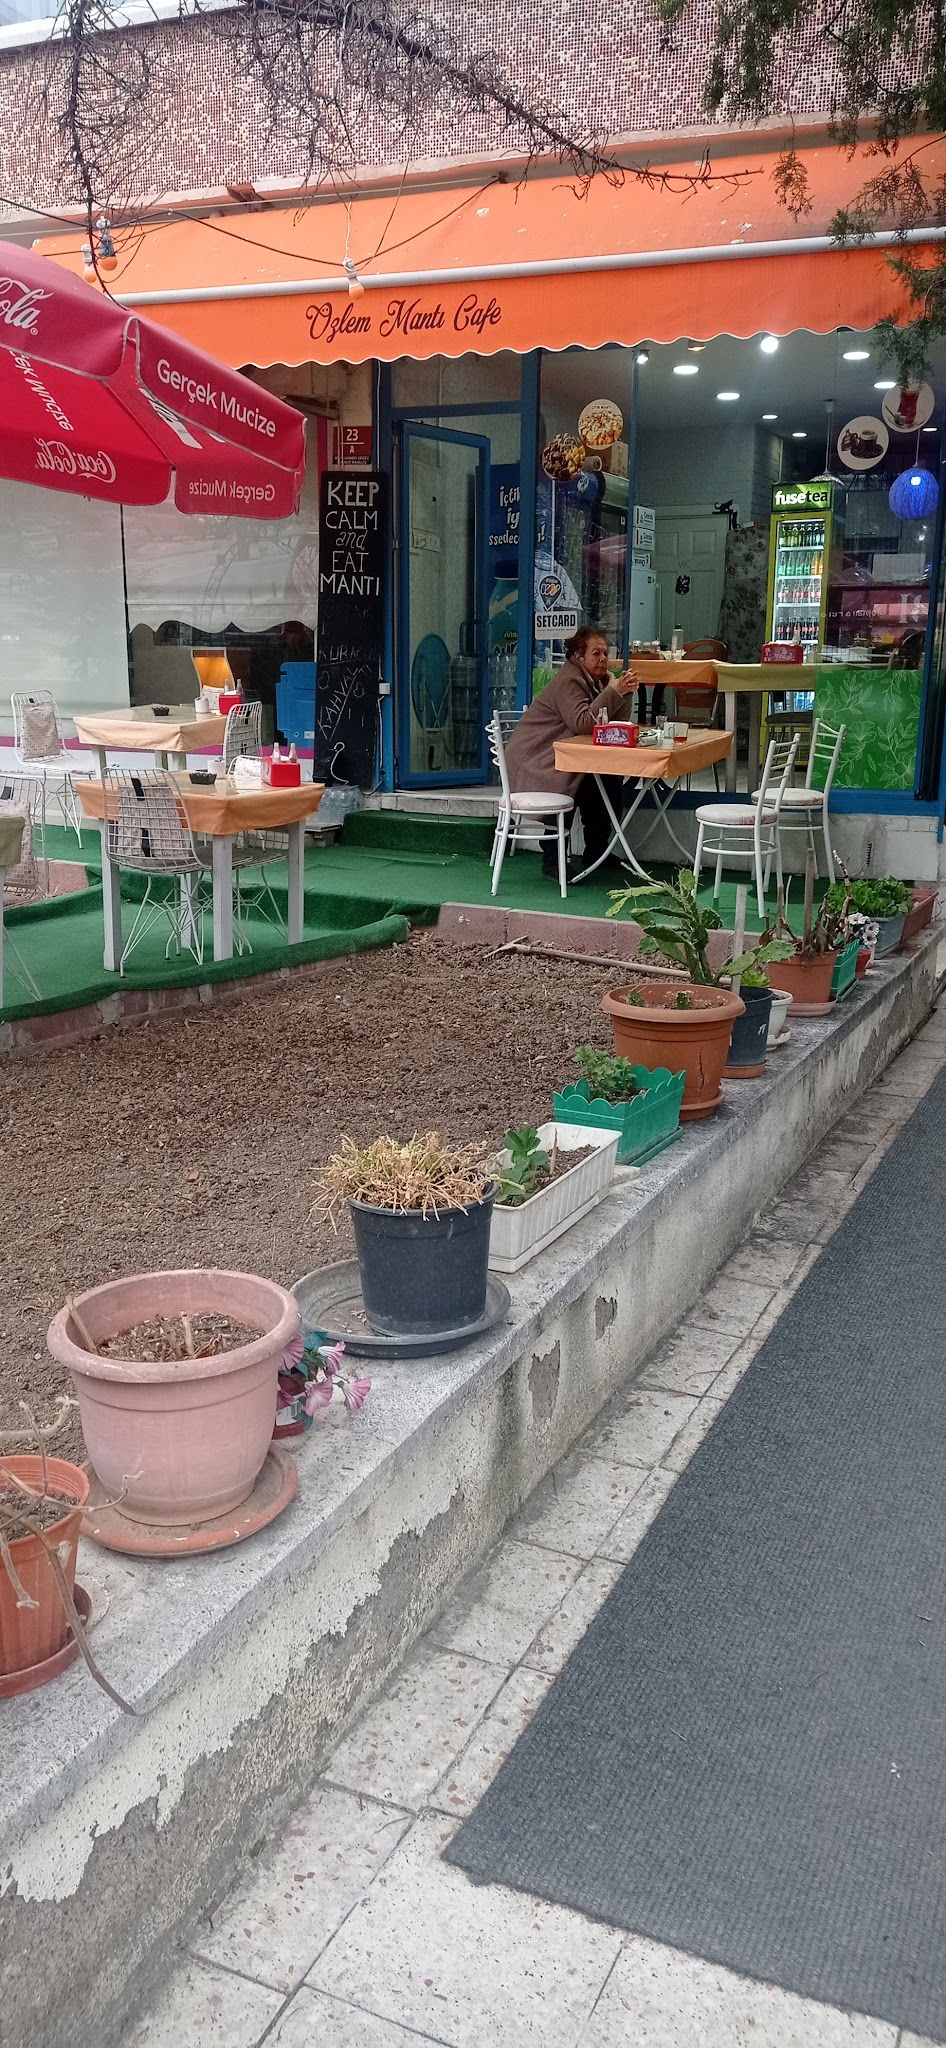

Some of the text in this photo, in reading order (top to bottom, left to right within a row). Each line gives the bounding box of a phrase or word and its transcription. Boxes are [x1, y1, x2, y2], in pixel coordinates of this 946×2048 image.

[306, 293, 502, 343] Özlem Mantı Cafe
[157, 358, 277, 438] Gerçek Mucize
[346, 428, 359, 441] 23
[327, 481, 380, 507] KEEP
[774, 490, 829, 506] fusetea
[325, 510, 379, 530] CALM
[335, 529, 367, 551] and
[332, 551, 369, 573] EAT
[319, 573, 380, 596] MANTI
[536, 614, 576, 628] SETCARD
